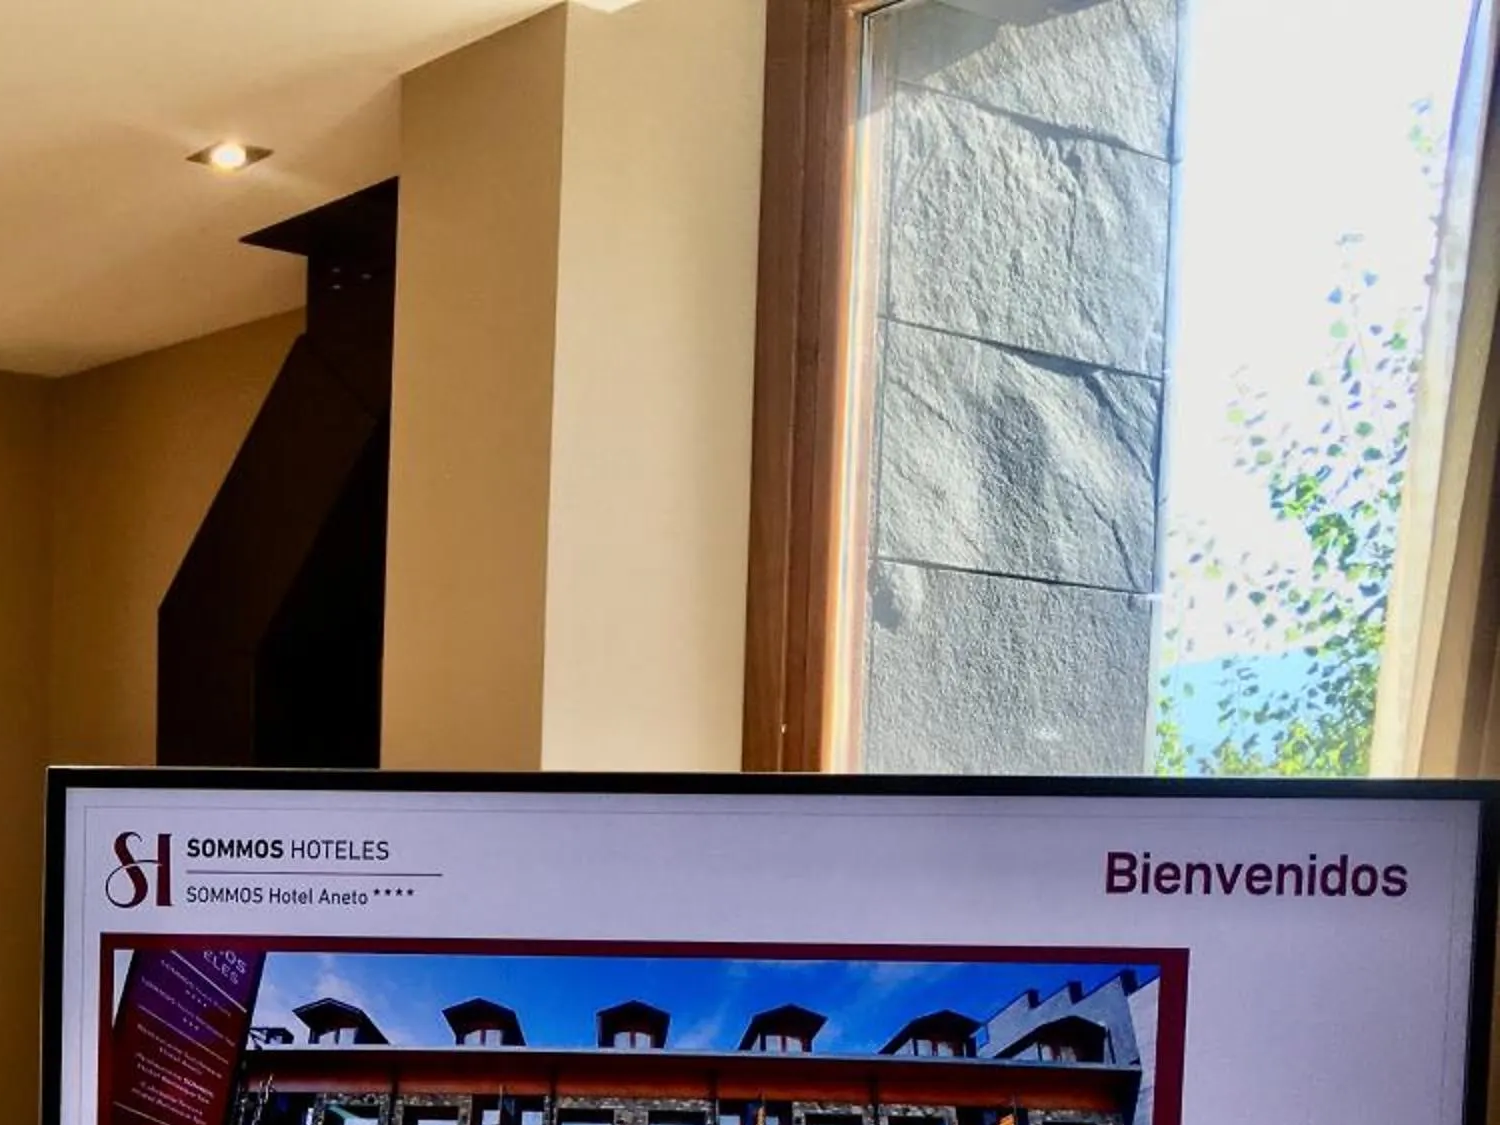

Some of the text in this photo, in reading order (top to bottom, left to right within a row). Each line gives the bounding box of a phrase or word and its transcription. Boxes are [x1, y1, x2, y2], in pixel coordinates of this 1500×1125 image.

[187, 838, 390, 861] SOMMOS HOTELES
[1105, 851, 1408, 898] Bienvenidos
[186, 886, 369, 906] SOMMOS Hotel Aneto
